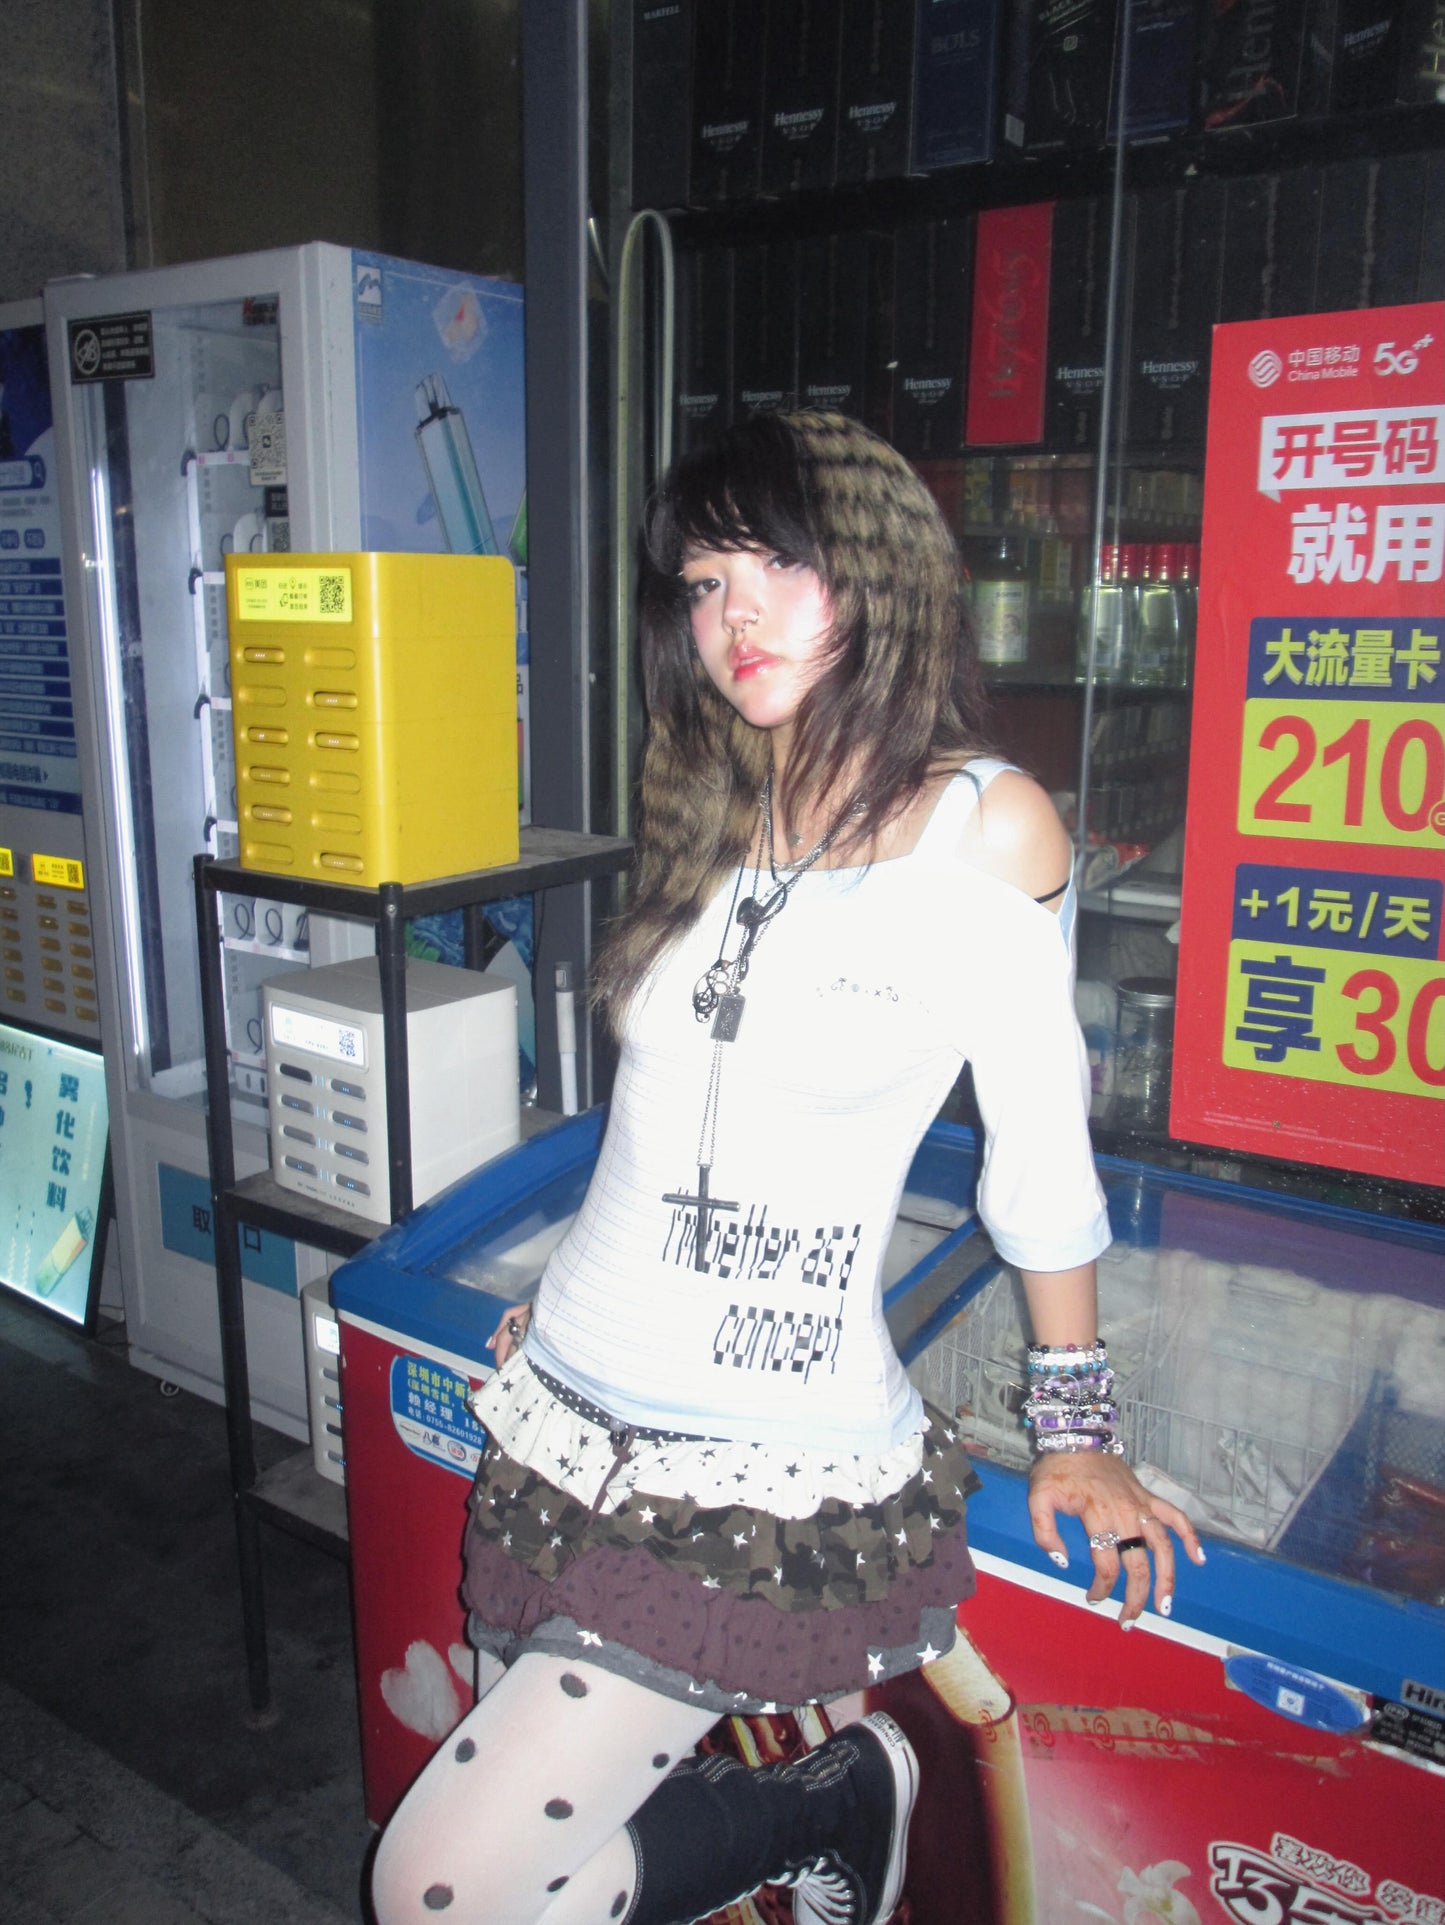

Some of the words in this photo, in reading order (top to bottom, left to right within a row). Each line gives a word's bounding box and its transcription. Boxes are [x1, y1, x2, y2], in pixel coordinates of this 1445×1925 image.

[773, 107, 825, 128] Hennessy
[847, 101, 898, 120] Hennessy
[701, 119, 751, 139] Hennessy
[1287, 344, 1361, 368] 中国移动
[1141, 360, 1199, 376] Hennessy
[1287, 369, 1321, 382] China
[1321, 366, 1359, 380] Mobile
[807, 384, 852, 398] Hennessy
[903, 377, 952, 392] Hennessy
[1273, 416, 1439, 481] 开号码
[1286, 503, 1445, 584] 就用
[1263, 628, 1441, 690] 大流量卡
[1254, 715, 1445, 832] 210
[1240, 886, 1432, 942] +1元/天
